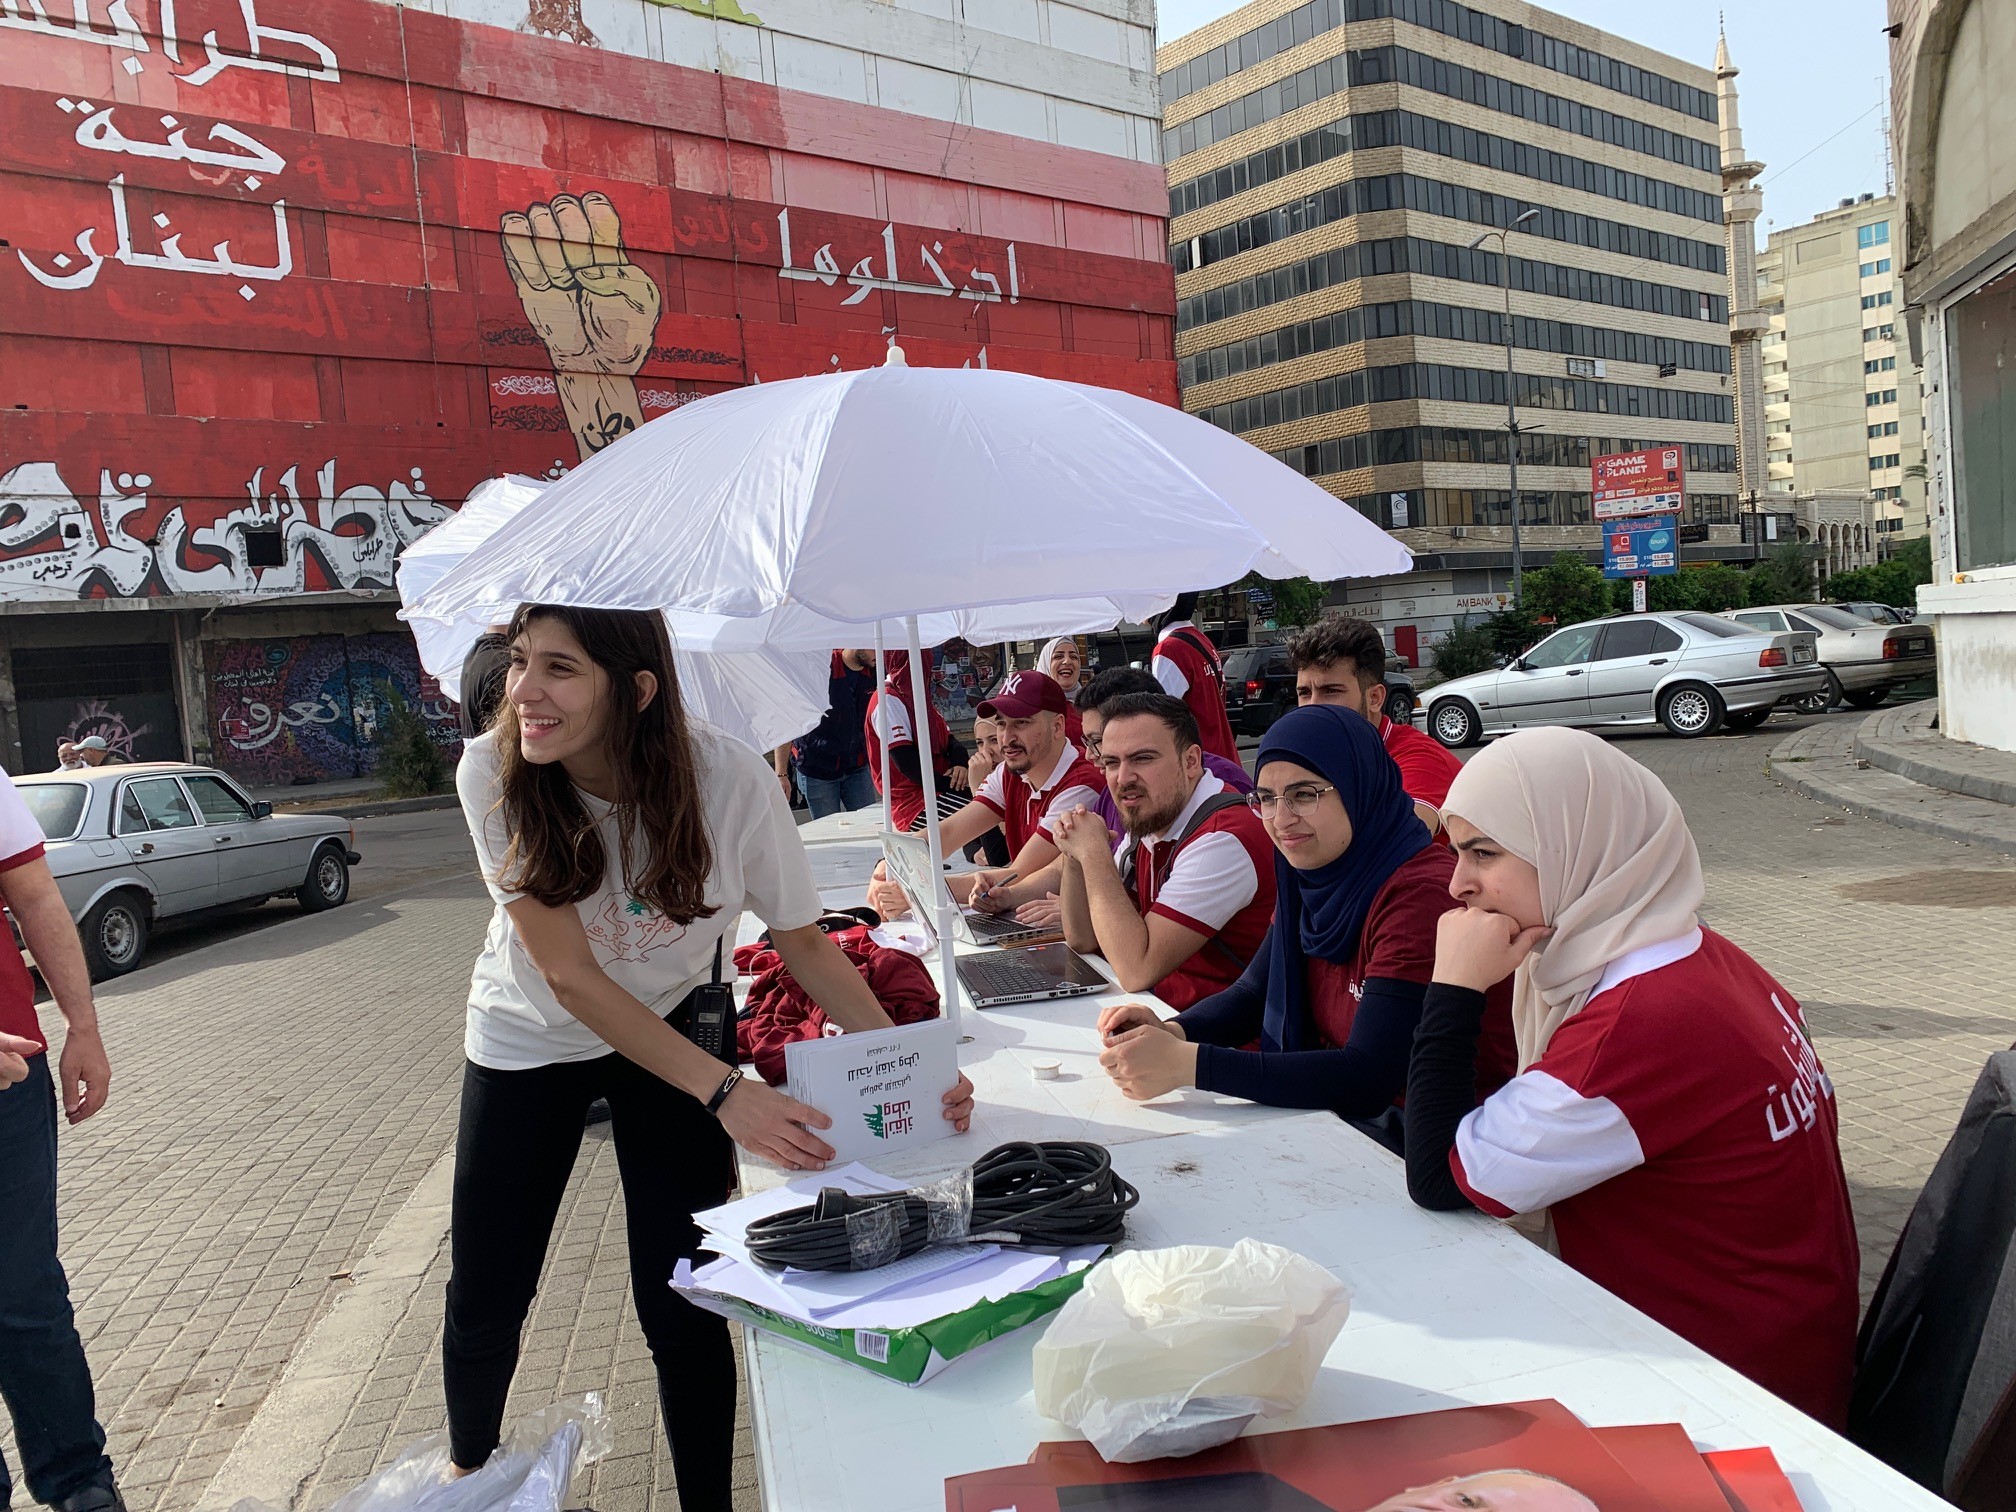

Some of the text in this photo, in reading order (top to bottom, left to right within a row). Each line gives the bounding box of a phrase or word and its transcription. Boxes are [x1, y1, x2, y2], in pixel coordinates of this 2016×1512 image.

[55, 97, 287, 190] جنة
[17, 173, 293, 301] لبنان
[776, 206, 1021, 307] ادخلوها
[1606, 455, 1646, 468] GAME
[1606, 464, 1648, 477] PLANET
[1469, 597, 1493, 607] BANK
[1358, 606, 1380, 617] بنك
[999, 674, 1022, 695] NY
[898, 1052, 920, 1068] وطن
[860, 1082, 883, 1097] البرنامج
[884, 1100, 911, 1119] وطن
